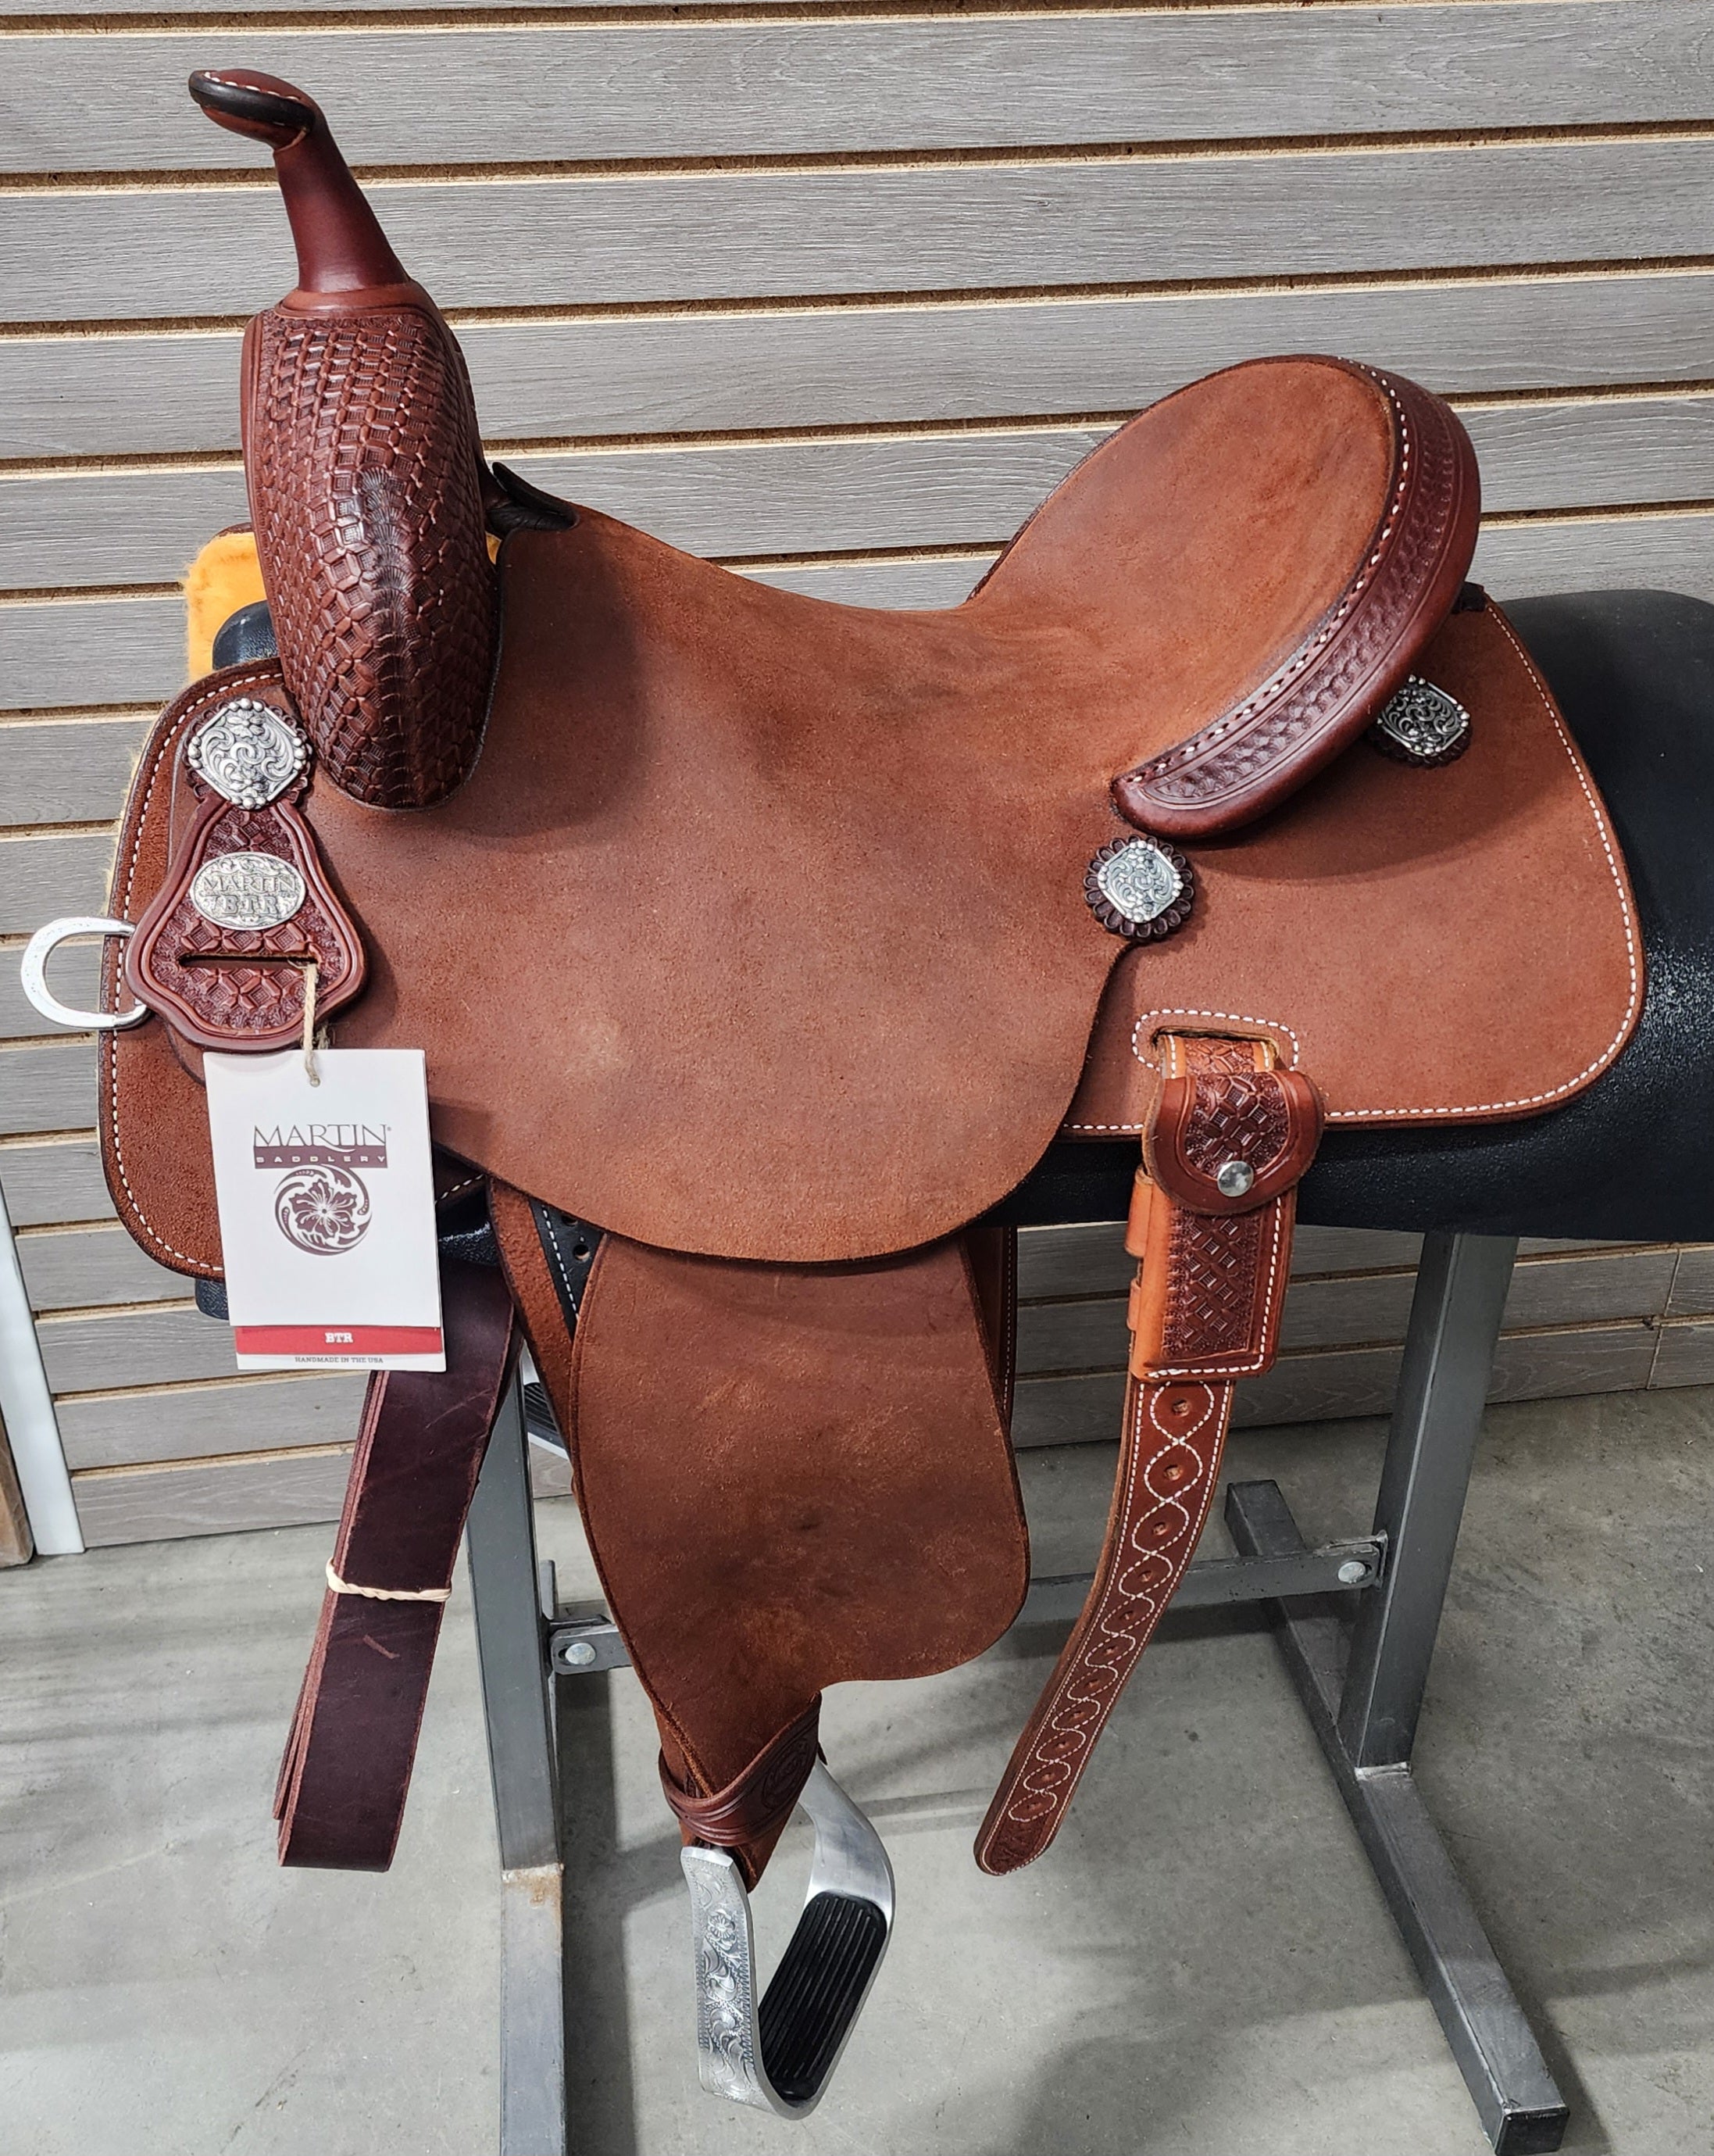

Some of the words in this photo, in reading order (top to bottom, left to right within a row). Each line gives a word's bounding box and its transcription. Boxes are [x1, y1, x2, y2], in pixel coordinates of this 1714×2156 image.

[203, 875, 296, 894] MARTIN
[222, 895, 278, 915] BTR
[325, 1332, 353, 1343] BTR
